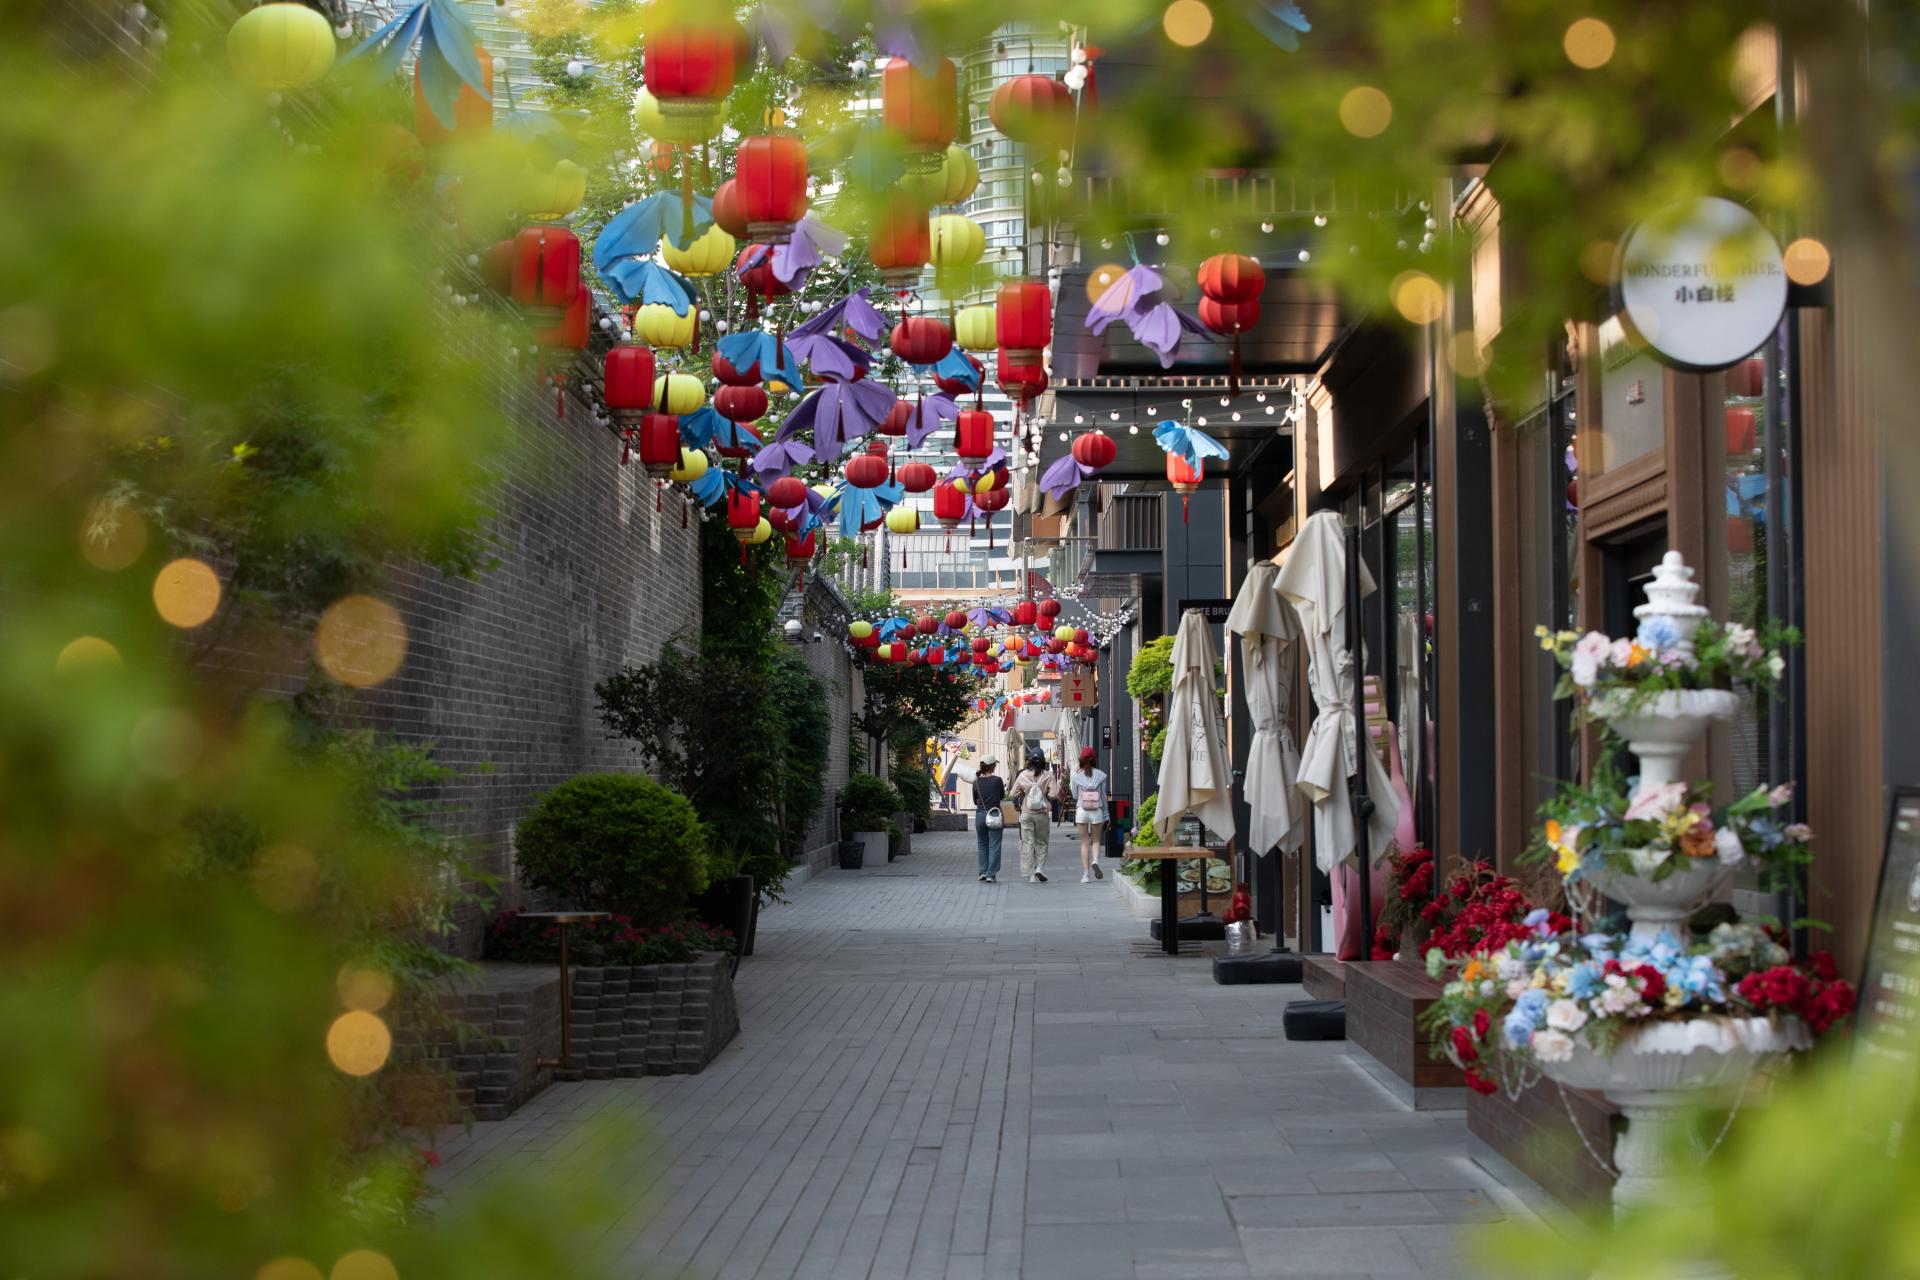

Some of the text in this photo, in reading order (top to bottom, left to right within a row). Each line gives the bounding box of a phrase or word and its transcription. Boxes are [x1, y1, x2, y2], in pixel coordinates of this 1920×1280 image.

[1675, 284, 1735, 304] 小白楼
[1212, 607, 1232, 616] BRU
